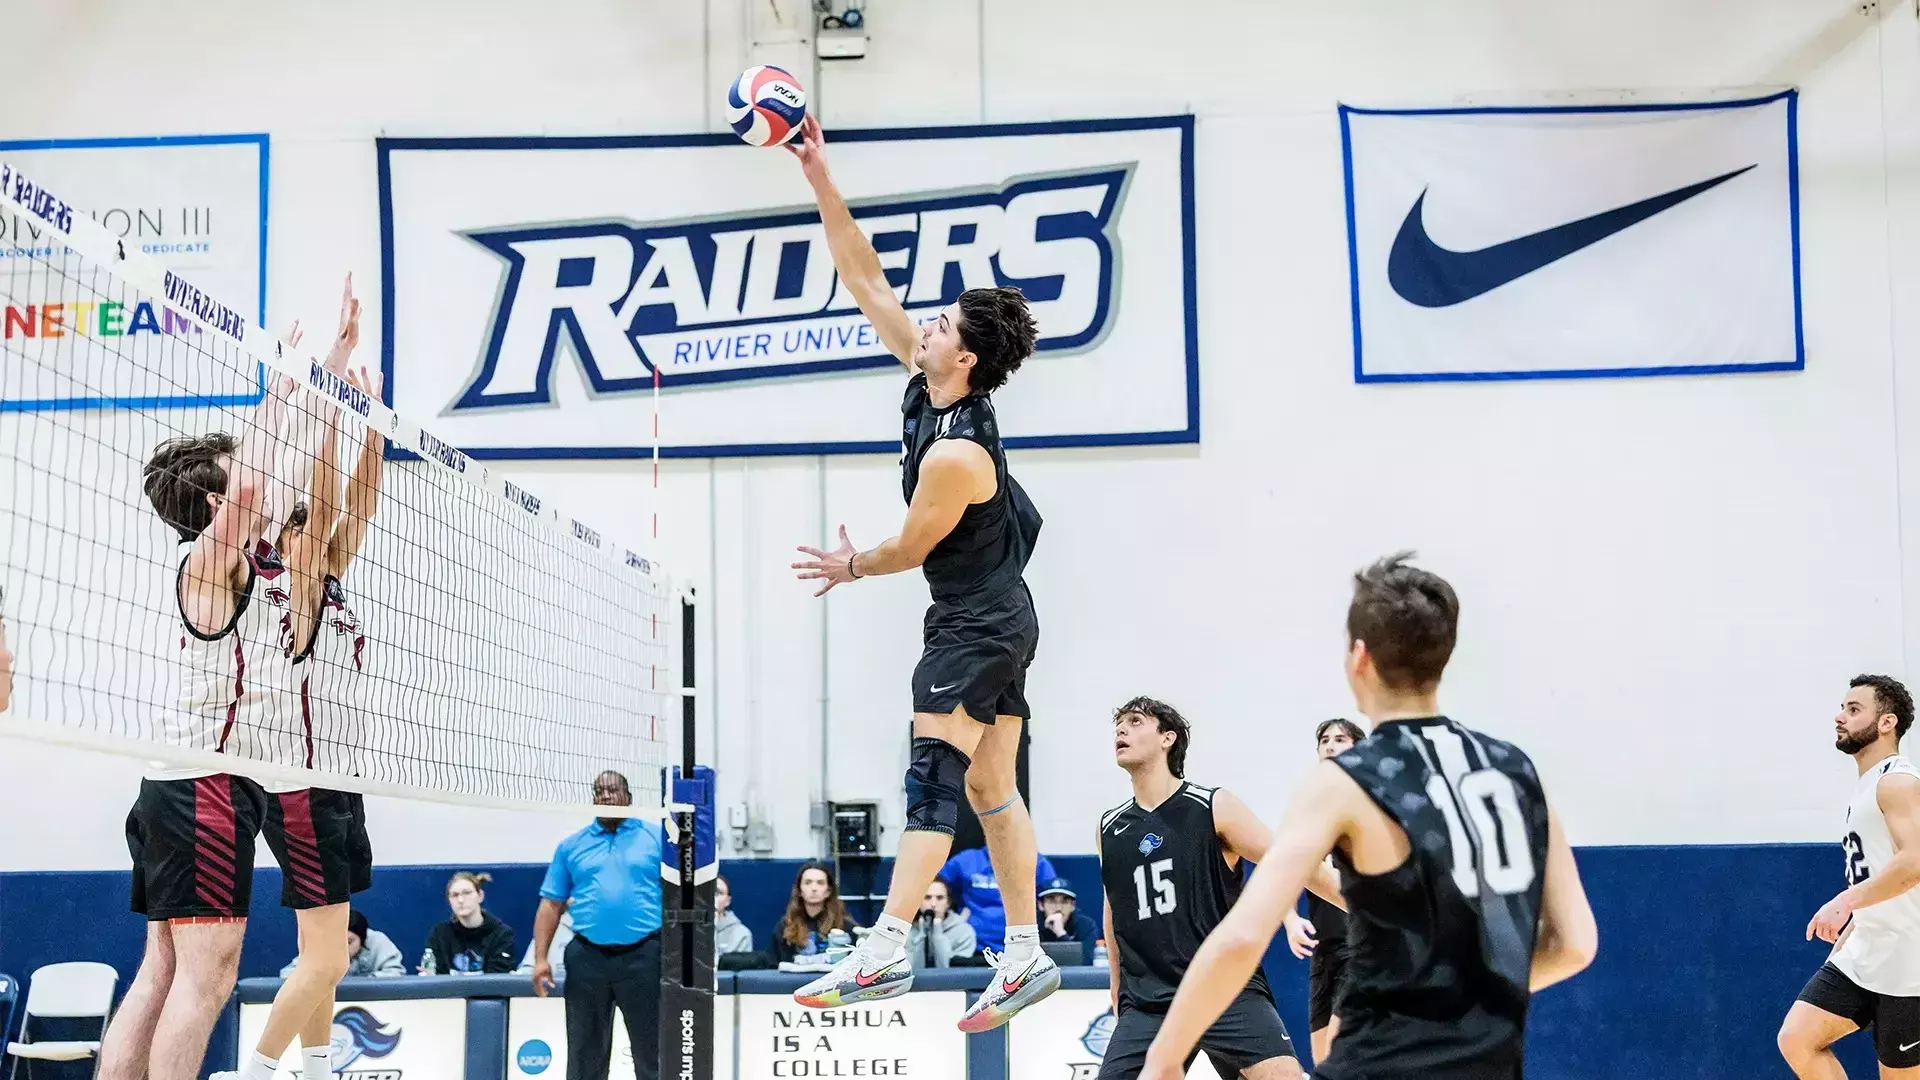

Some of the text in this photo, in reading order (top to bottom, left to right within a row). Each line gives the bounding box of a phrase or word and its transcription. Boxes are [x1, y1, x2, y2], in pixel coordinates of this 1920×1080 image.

[142, 243, 210, 254] DEDICATE
[482, 183, 1111, 396] RAIDERS
[0, 302, 203, 339] NETEAM
[674, 334, 771, 365] RIVIER
[1425, 767, 1536, 898] 10
[1133, 858, 1177, 921] 15
[679, 1009, 696, 1055] sports
[773, 1010, 907, 1028] NASHUA
[773, 1035, 833, 1053] IS A
[773, 1059, 908, 1077] COLLEGE
